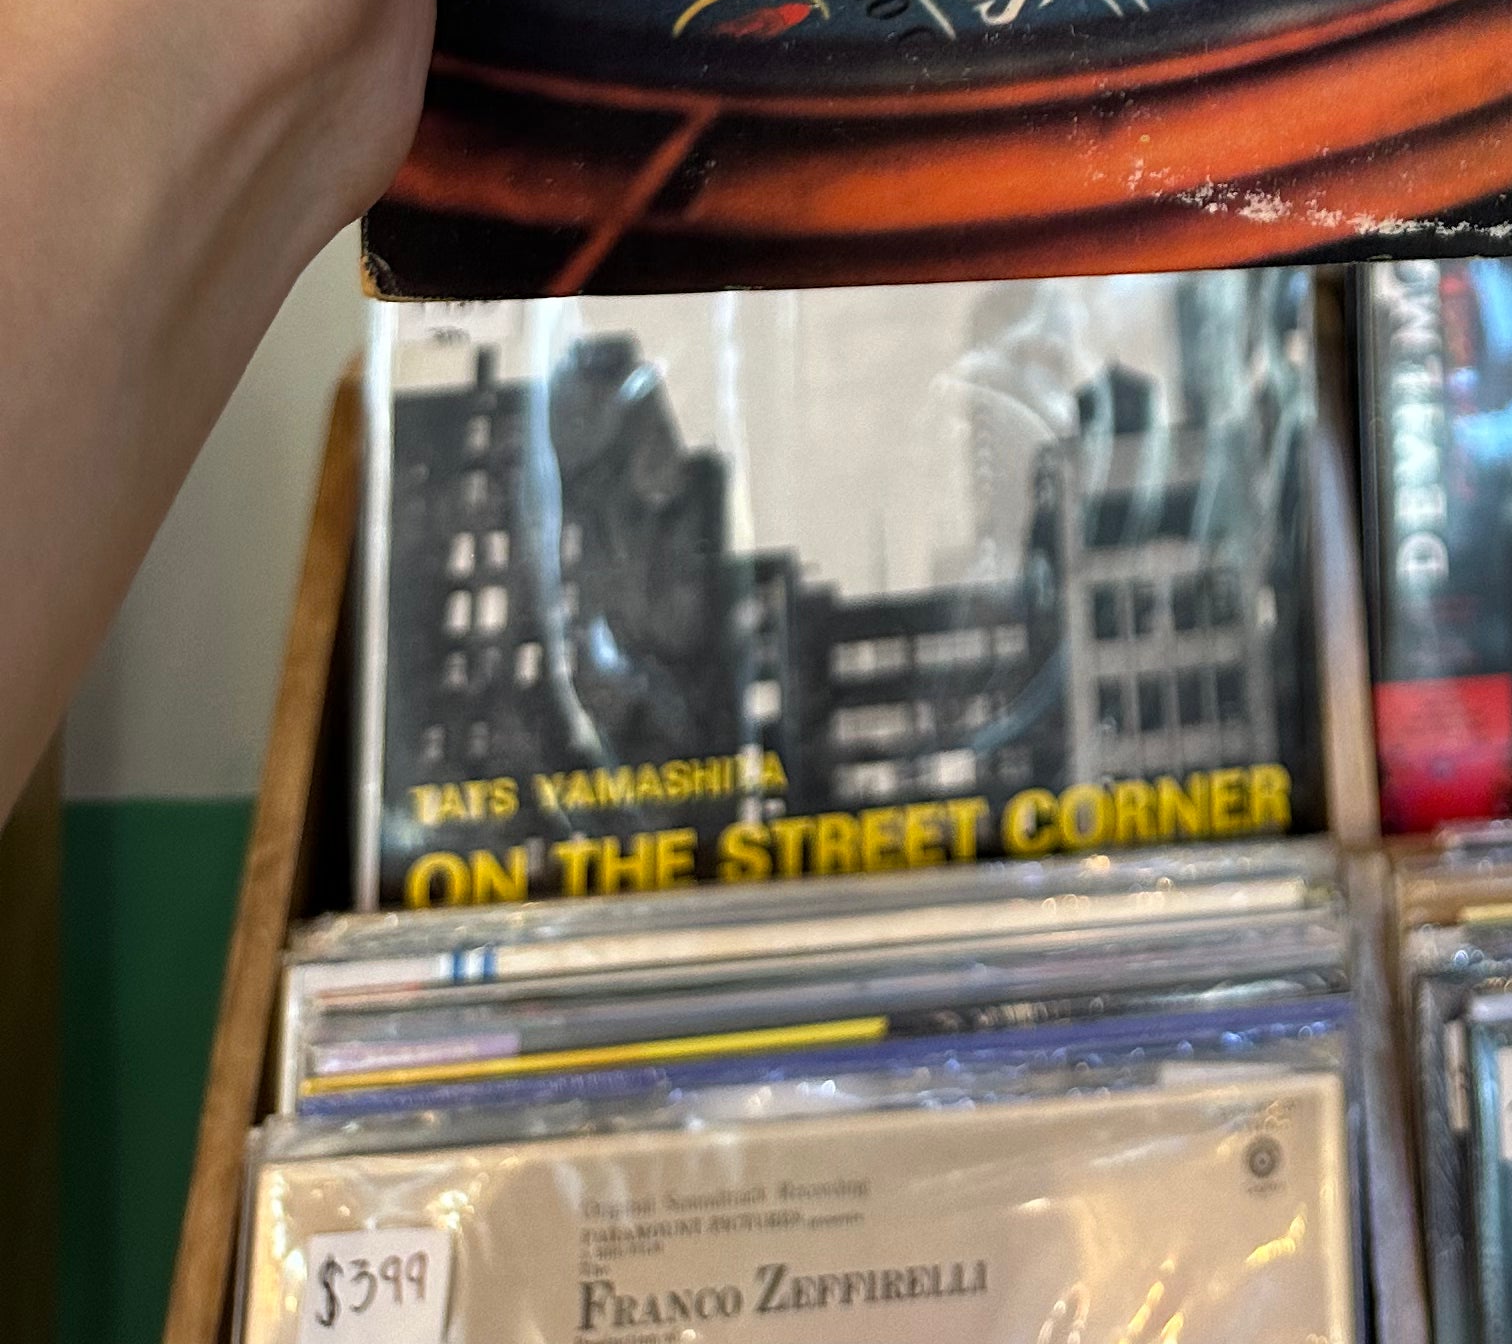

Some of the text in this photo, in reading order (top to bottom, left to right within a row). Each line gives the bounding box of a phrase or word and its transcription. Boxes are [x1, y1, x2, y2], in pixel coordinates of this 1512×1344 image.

[406, 762, 1294, 910] ON THE STREET CORNER
[409, 776, 520, 827] TATS
[314, 1252, 431, 1329] $399
[579, 1258, 989, 1331] FRANCO ZEFFIRELLI
